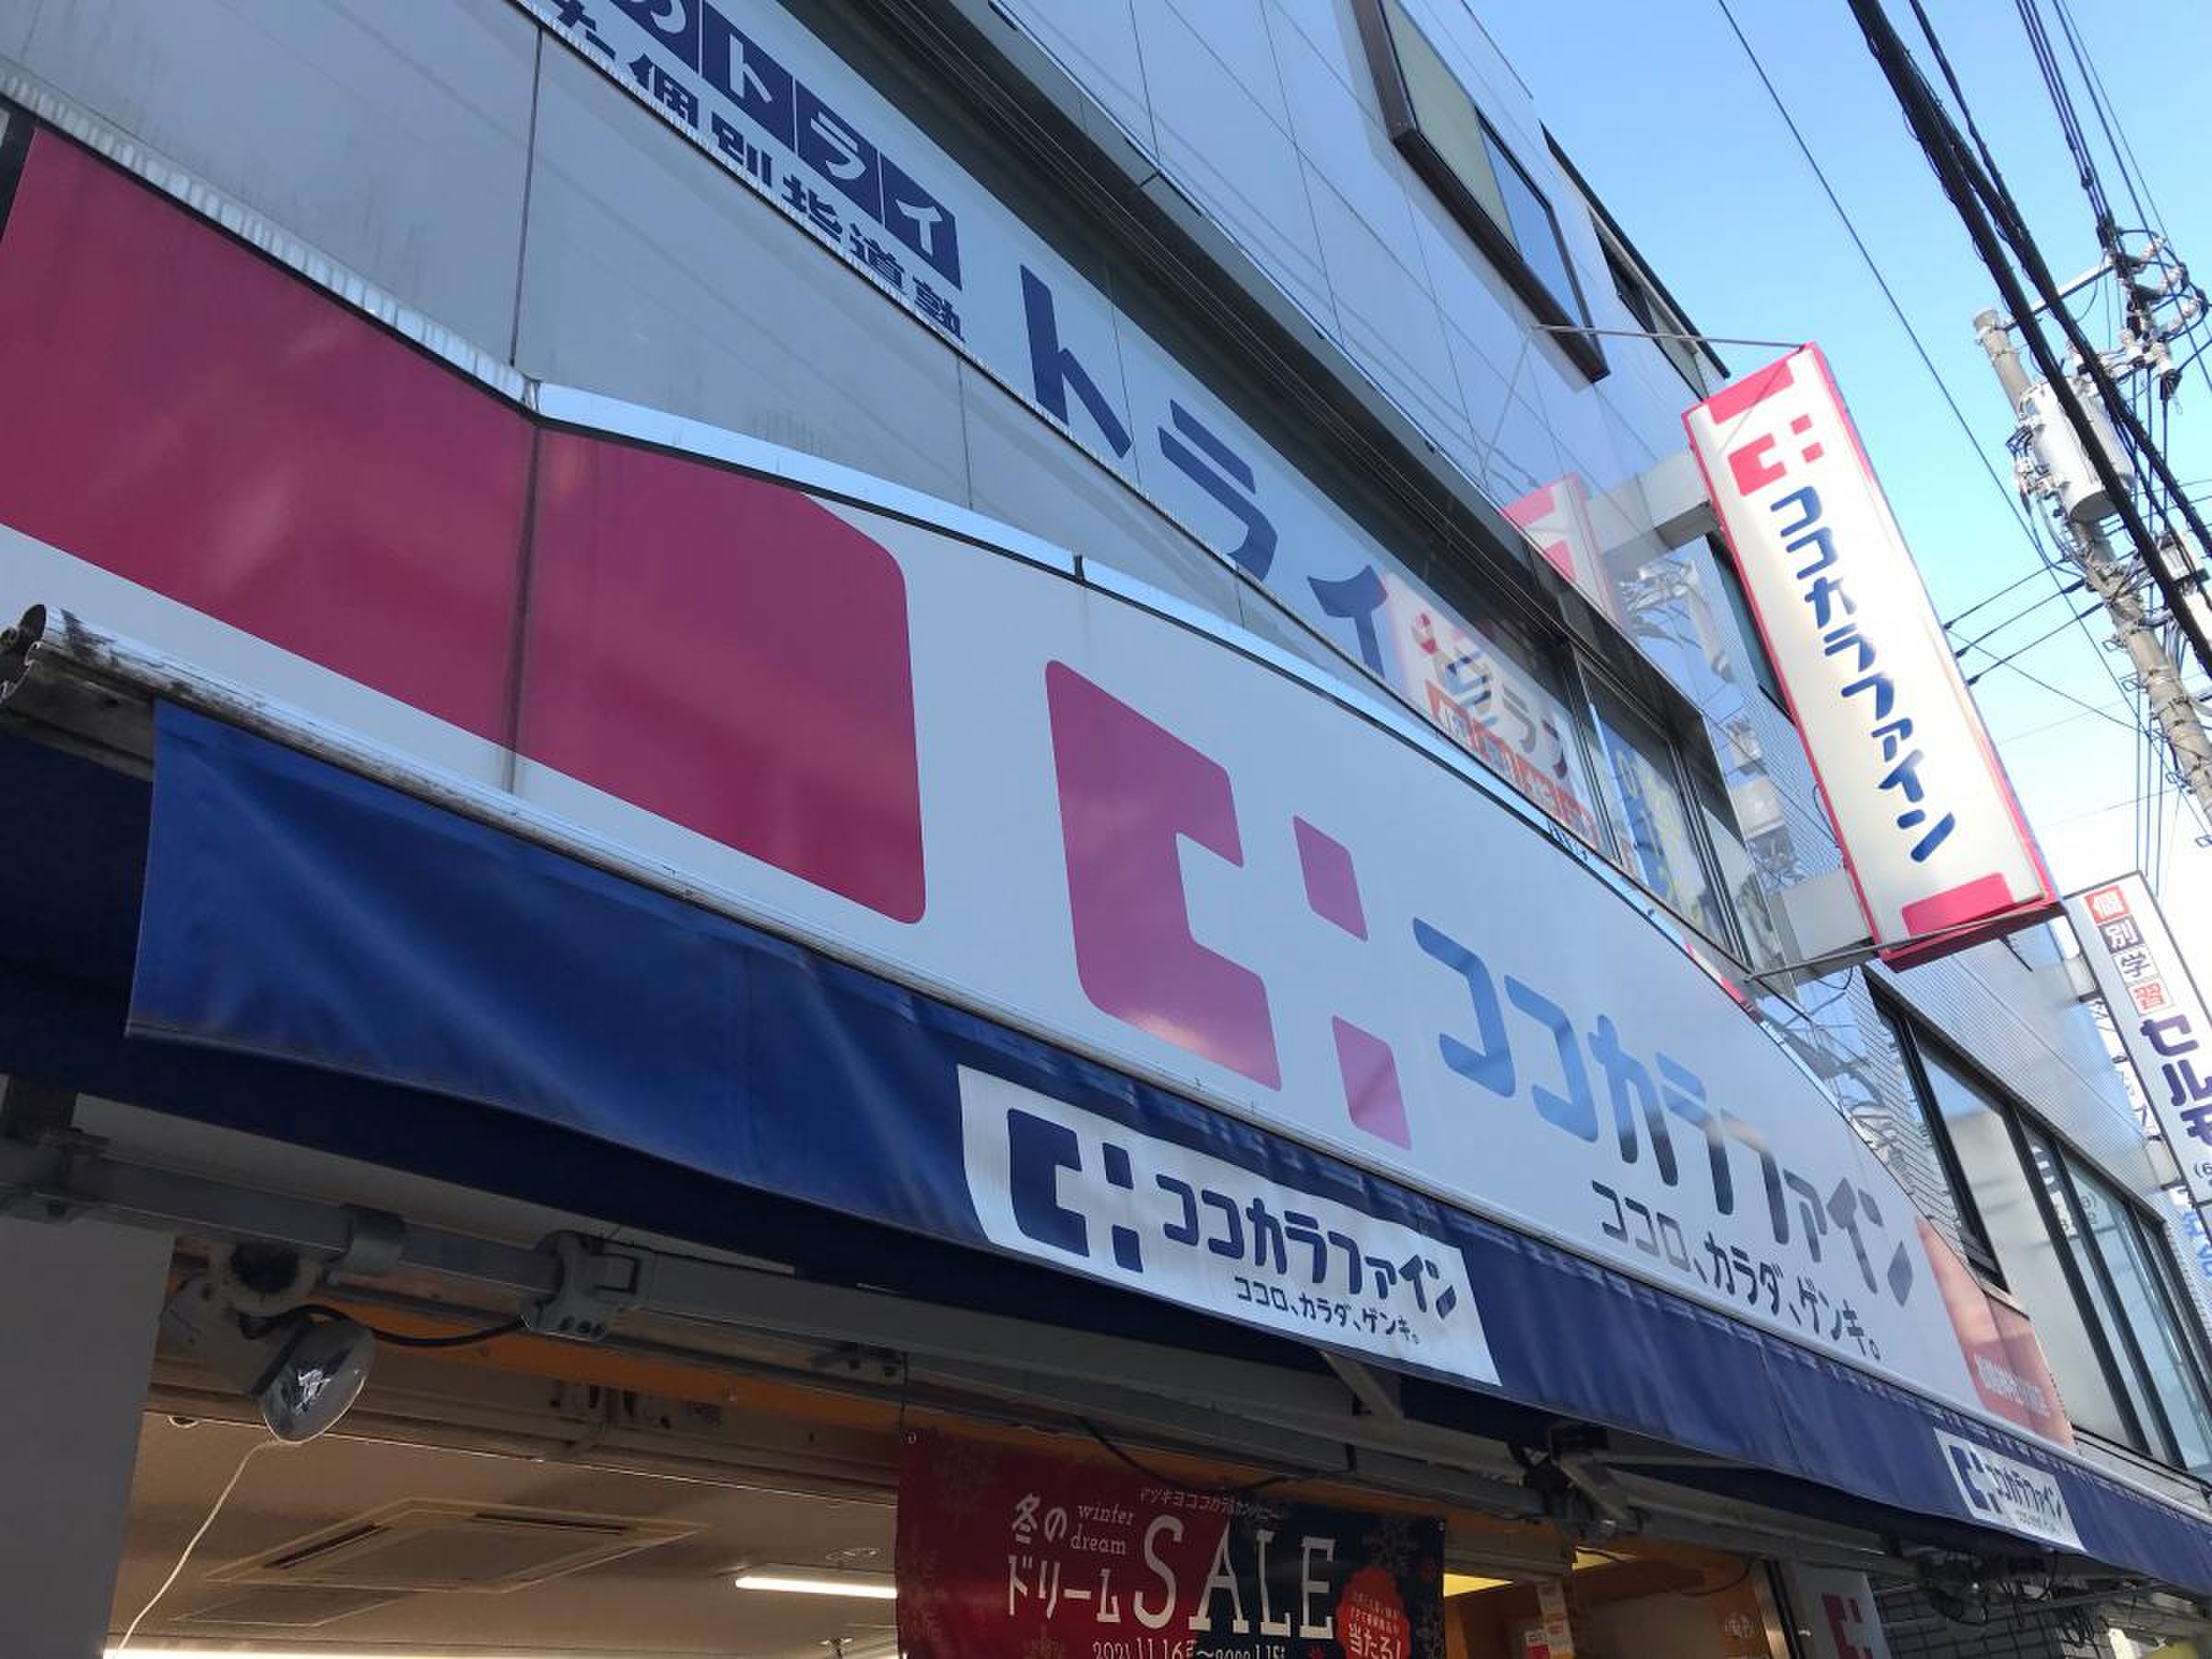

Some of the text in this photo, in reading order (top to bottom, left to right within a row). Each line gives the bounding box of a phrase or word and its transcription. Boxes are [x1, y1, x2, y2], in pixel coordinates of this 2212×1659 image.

[1019, 264, 1388, 681] トライ
[1770, 485, 1956, 864] ココカラファイン
[1413, 917, 1914, 1307] ココカラファイン
[1155, 1172, 1457, 1320] ココカラファイン
[1592, 1179, 1881, 1361] ココロ、カラダ、ゲンキ。
[1011, 1492, 1067, 1546] 冬の
[1070, 1524, 1127, 1557] dream
[1077, 1503, 1136, 1527] winter
[1133, 1513, 1335, 1640] SALE
